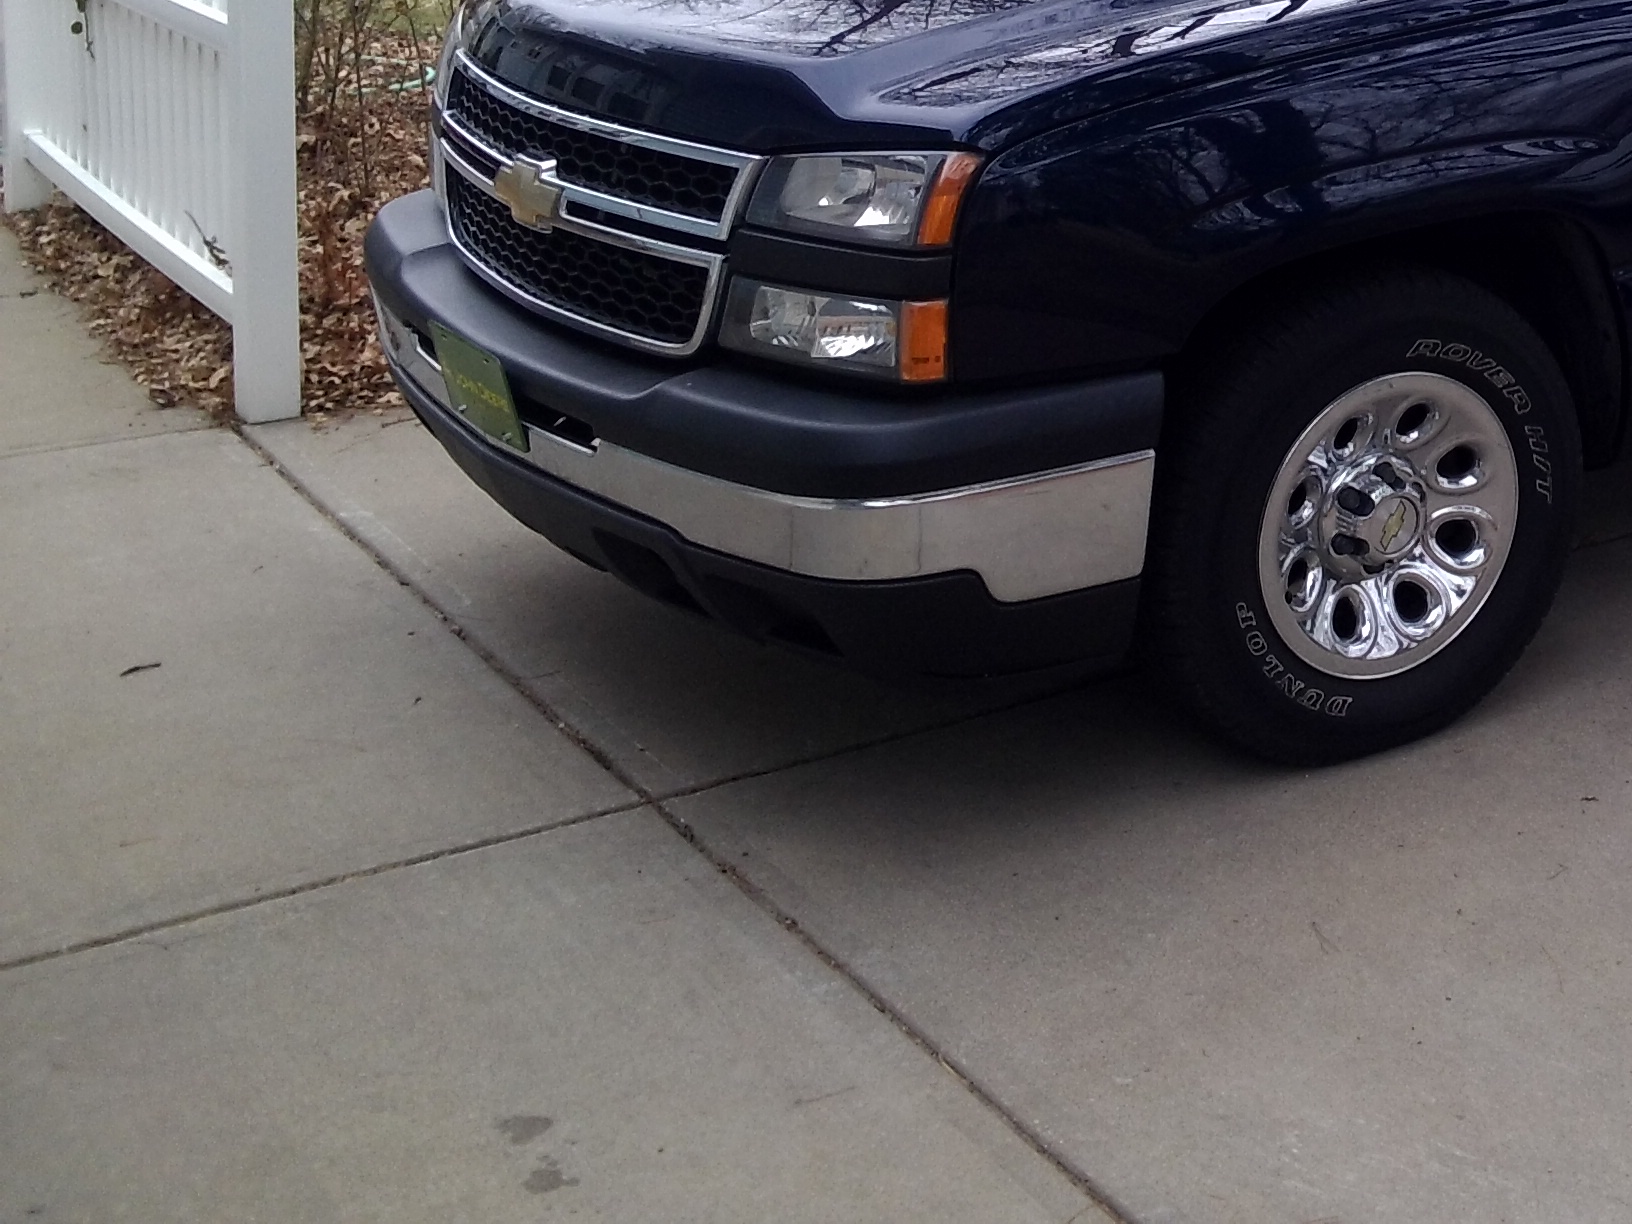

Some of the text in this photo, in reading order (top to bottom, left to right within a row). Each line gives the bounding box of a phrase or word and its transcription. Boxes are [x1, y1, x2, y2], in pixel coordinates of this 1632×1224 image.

[1406, 338, 1553, 504] ROVER H/T
[1235, 602, 1353, 717] DUNLOP
